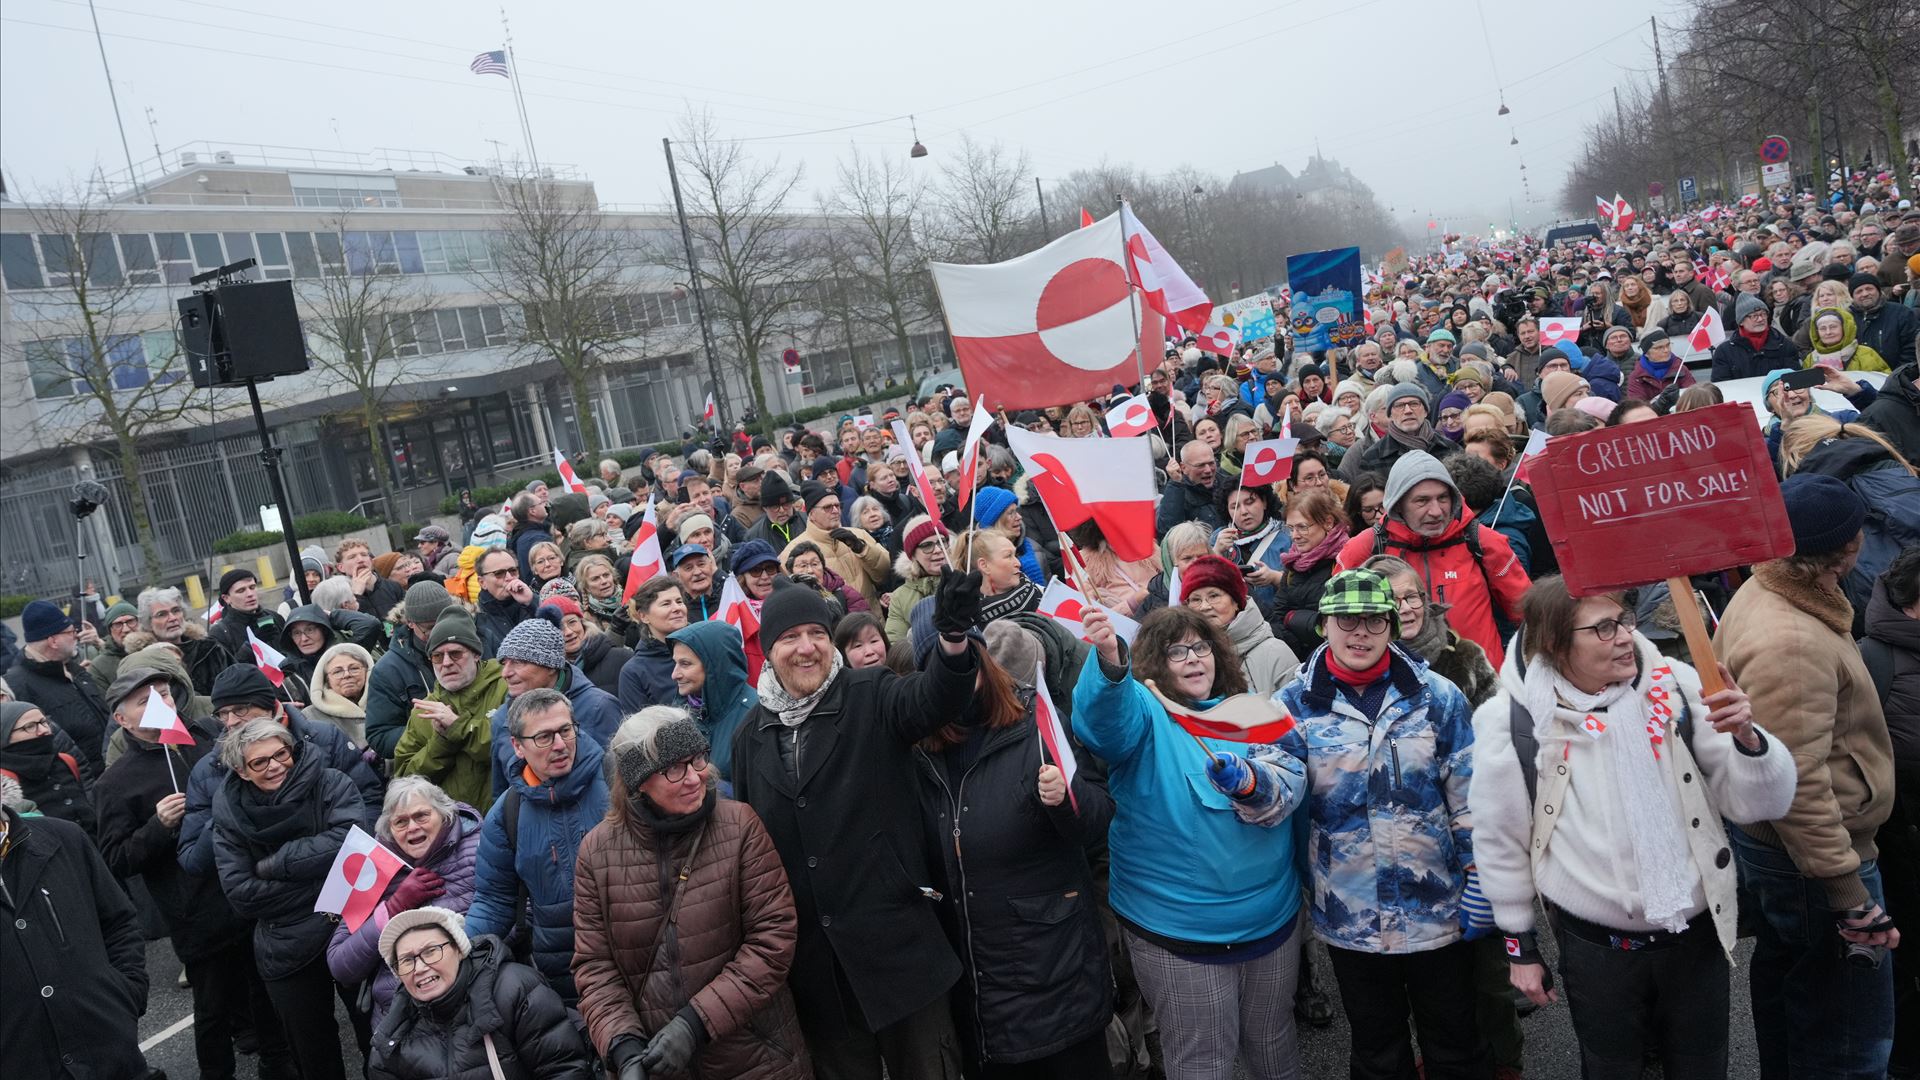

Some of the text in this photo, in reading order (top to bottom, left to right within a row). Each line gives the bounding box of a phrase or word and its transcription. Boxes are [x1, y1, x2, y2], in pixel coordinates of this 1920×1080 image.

[1683, 180, 1692, 190] P
[1577, 424, 1716, 475] GREENLAND
[1577, 469, 1749, 520] NOT FOR SALE!
[1444, 571, 1458, 580] HH
